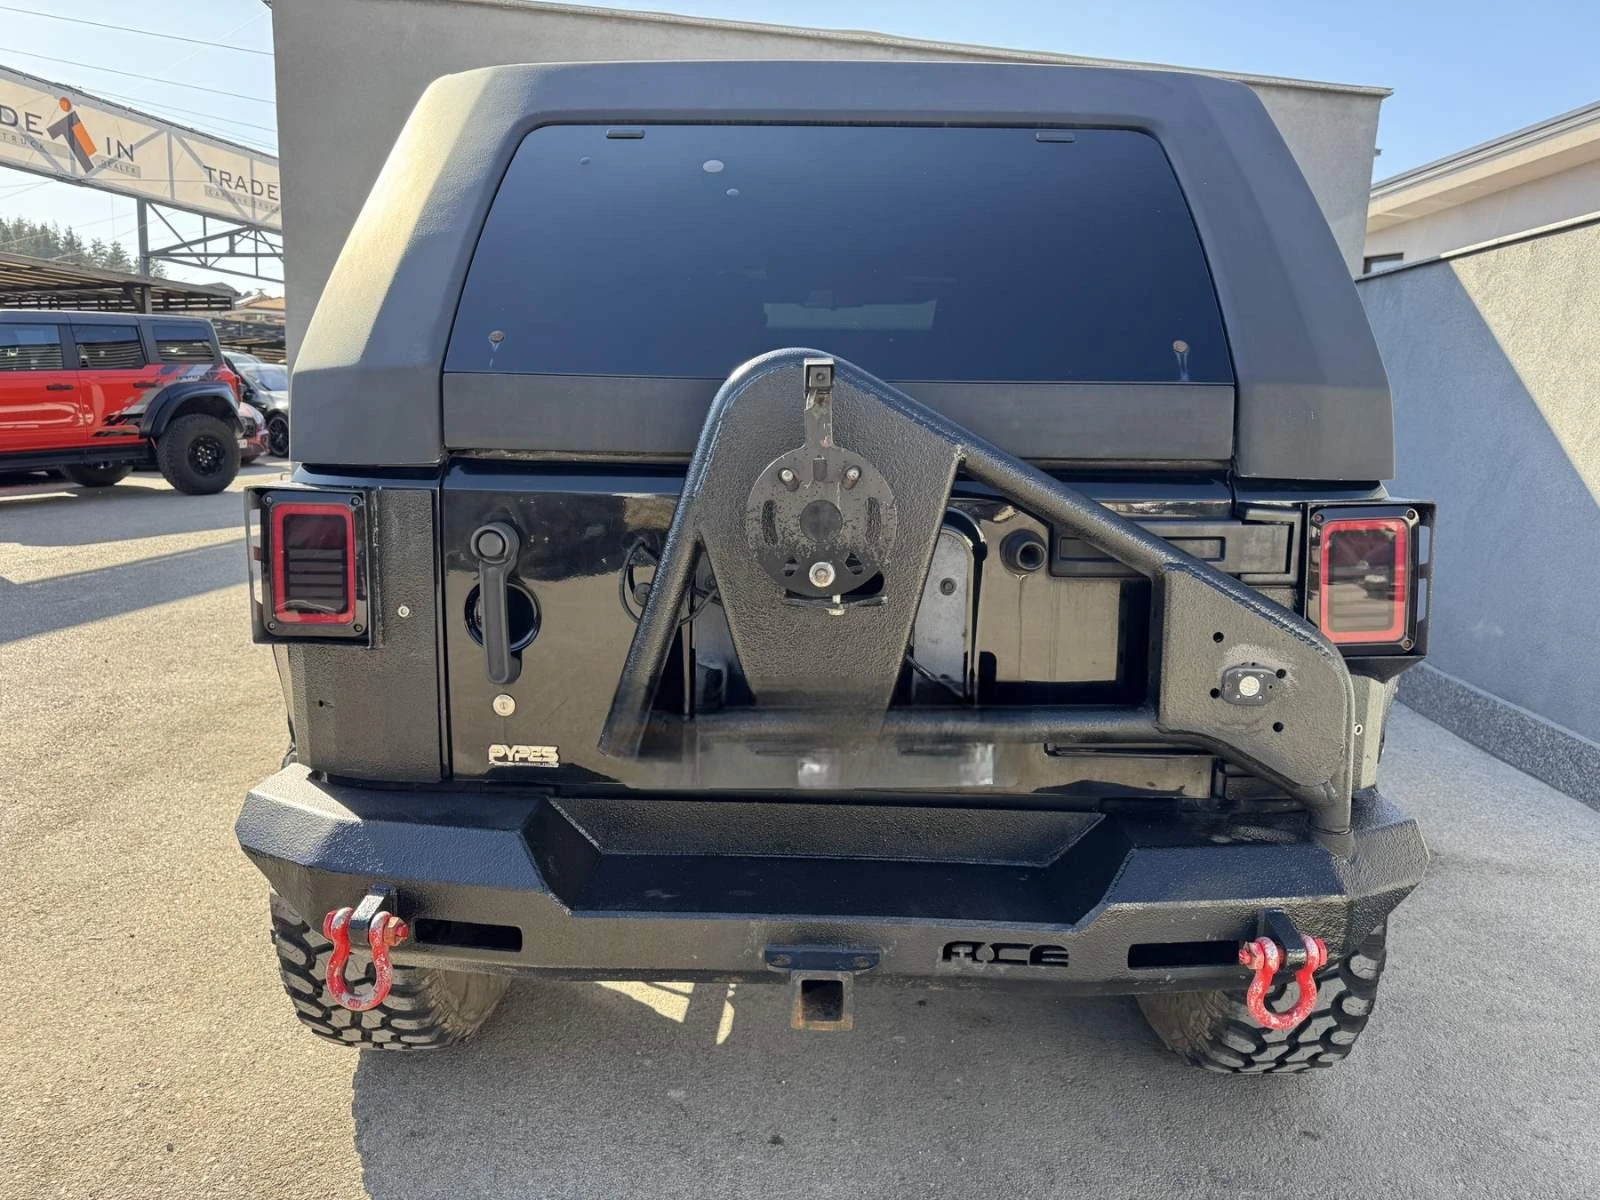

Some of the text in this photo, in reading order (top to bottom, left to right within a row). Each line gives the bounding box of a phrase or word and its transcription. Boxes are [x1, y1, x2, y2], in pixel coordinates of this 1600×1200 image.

[106, 136, 134, 162] IN
[202, 164, 279, 201] TRADE
[488, 744, 559, 763] PYPES
